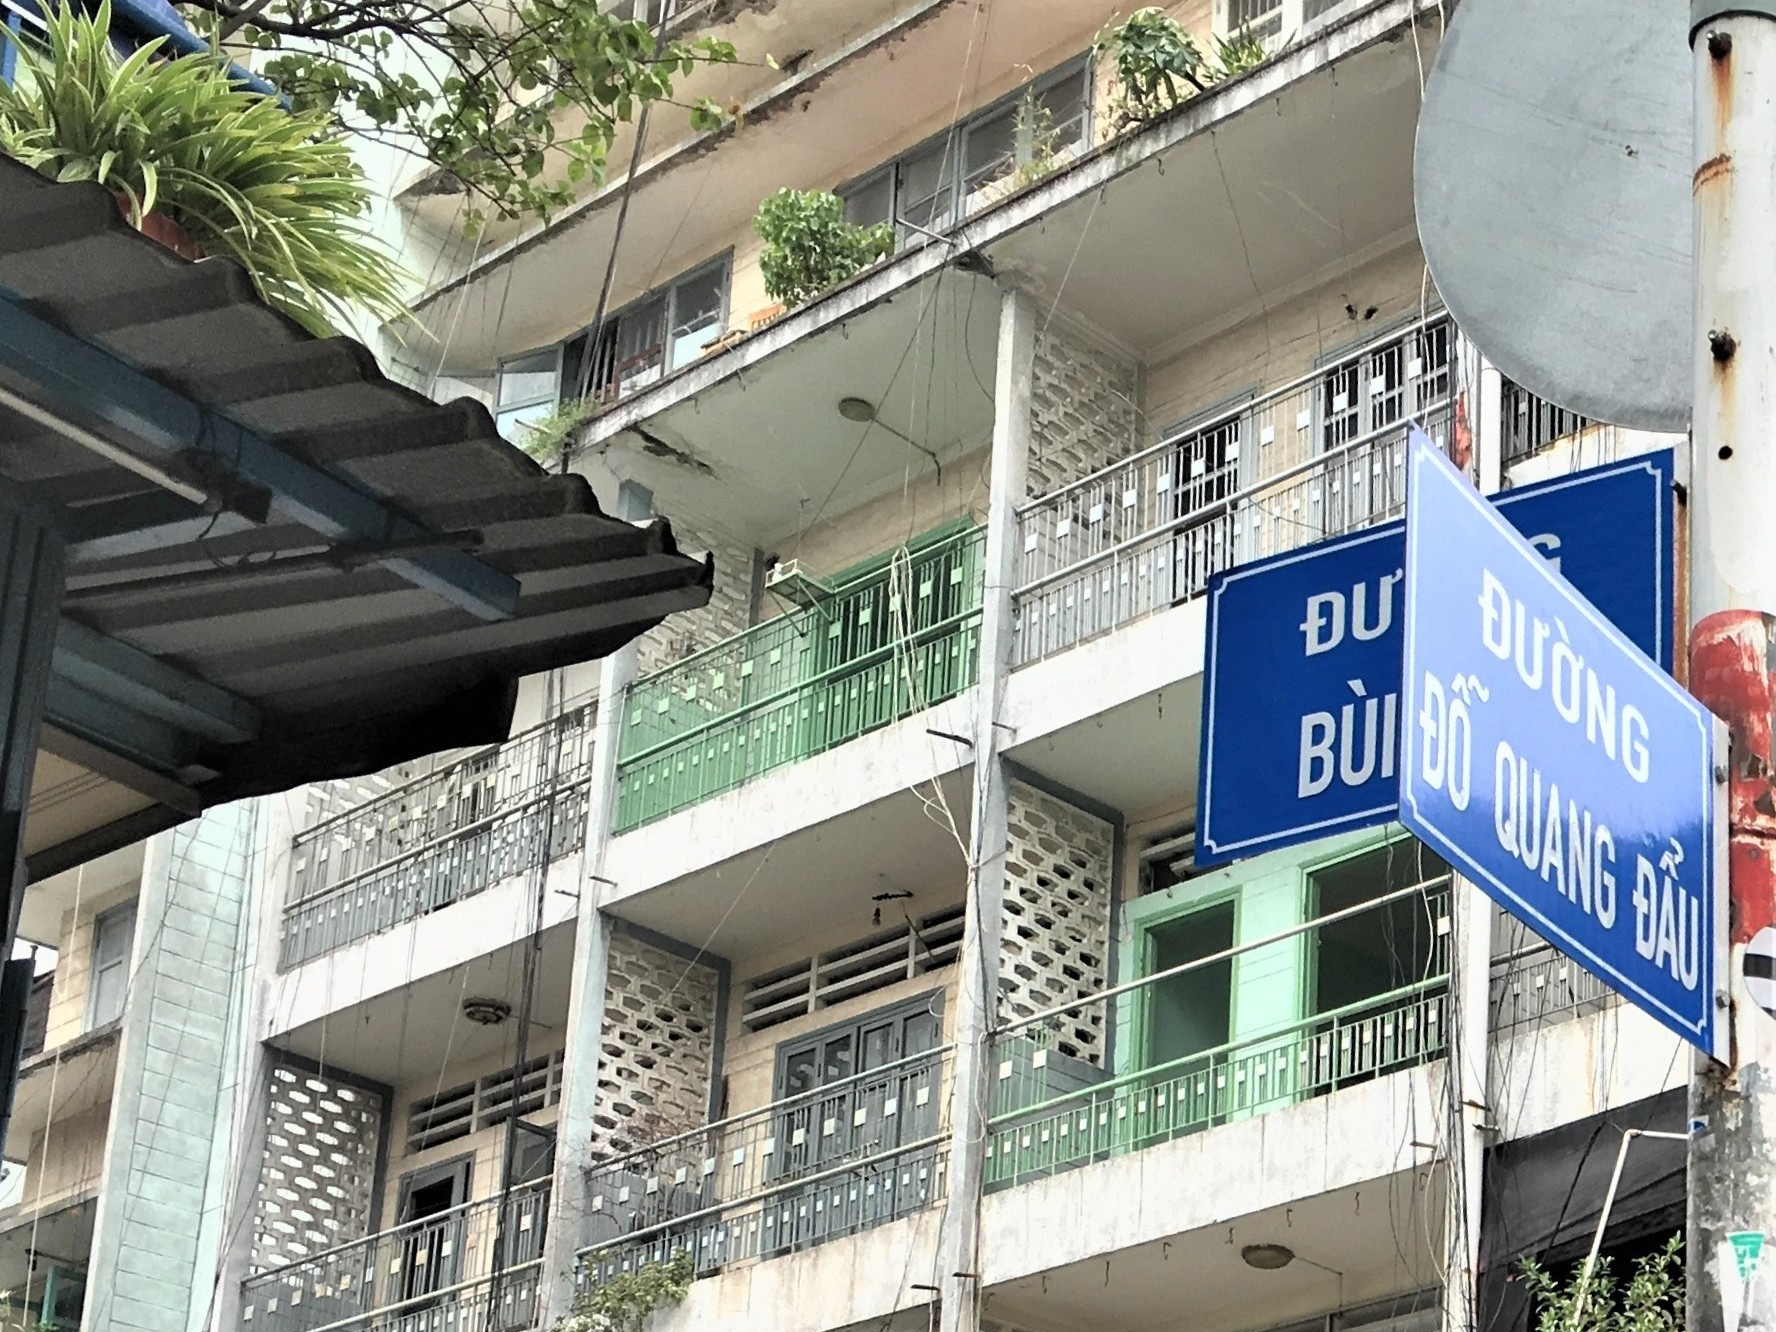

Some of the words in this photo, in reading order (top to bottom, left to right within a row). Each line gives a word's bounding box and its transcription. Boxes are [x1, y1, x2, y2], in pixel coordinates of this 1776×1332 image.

[1478, 568, 1650, 783] ĐƯỜNG
[1419, 670, 1489, 811] ĐỖ
[1495, 741, 1617, 930] QUANG
[1632, 837, 1699, 992] ĐẨU
